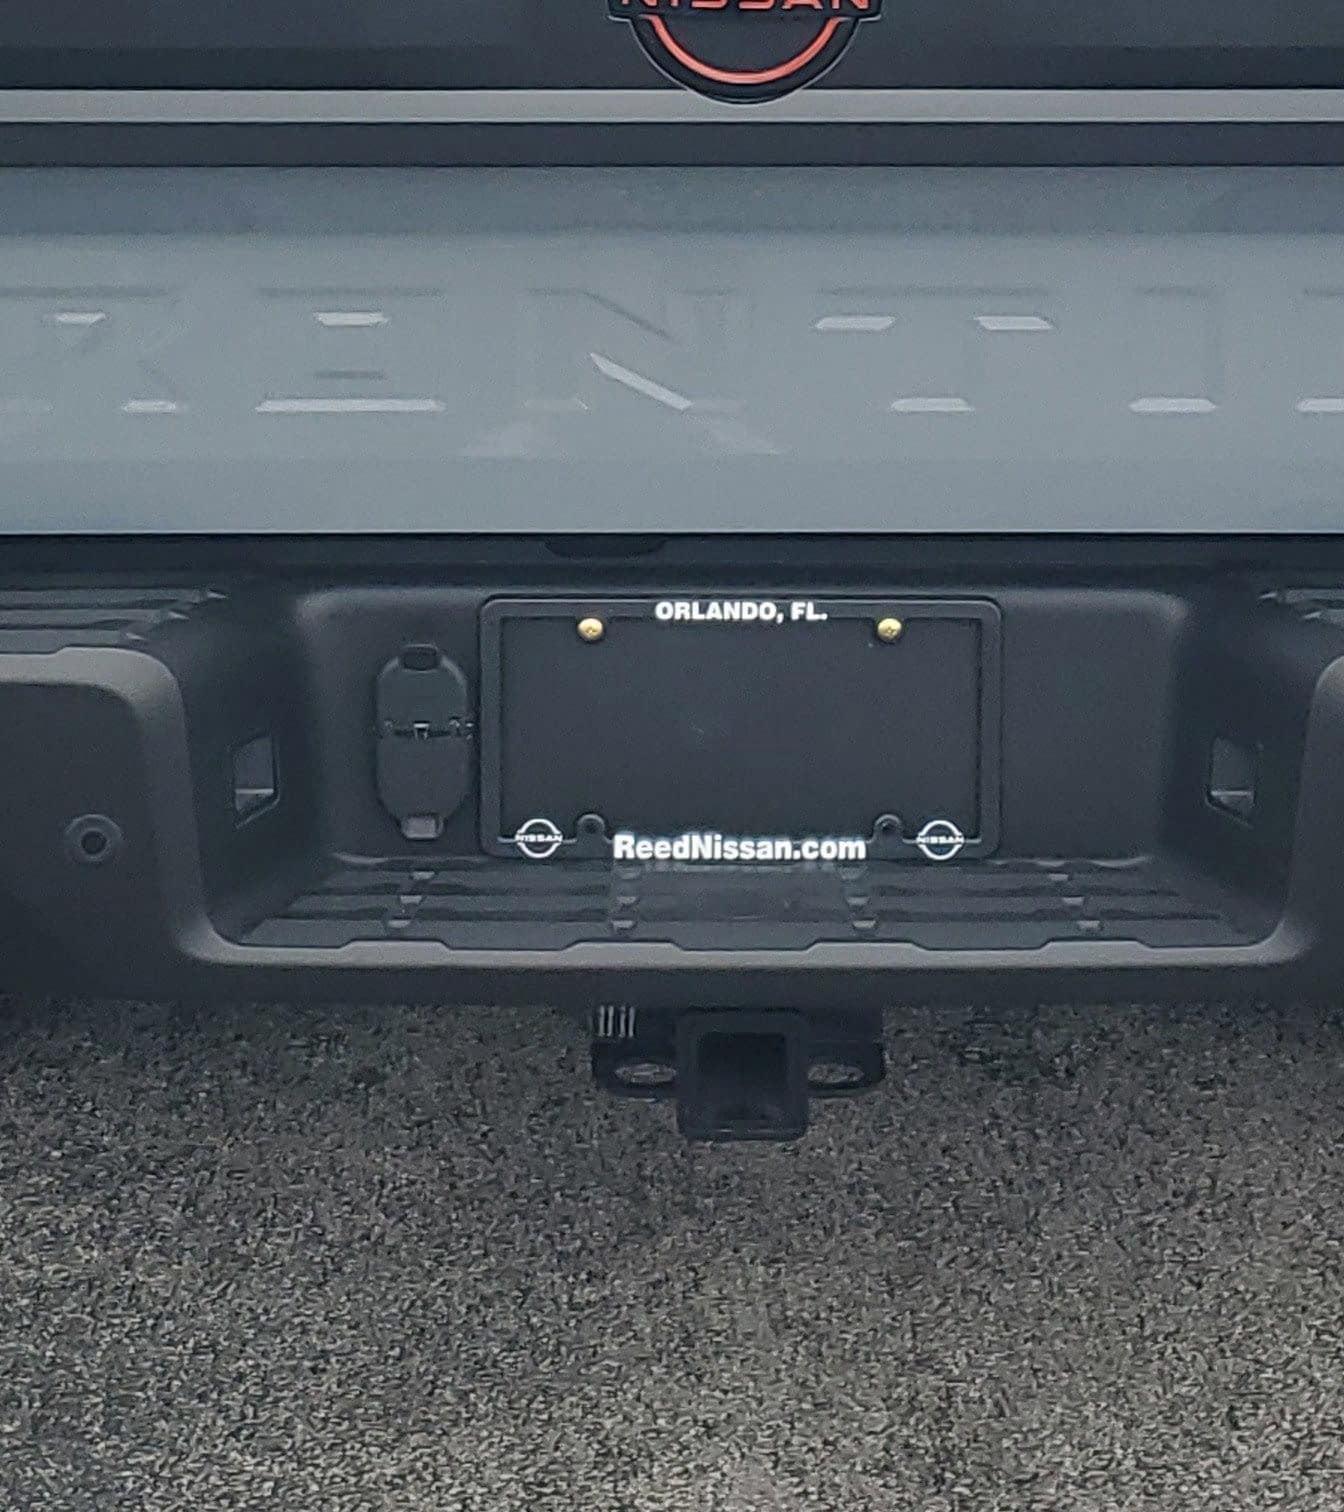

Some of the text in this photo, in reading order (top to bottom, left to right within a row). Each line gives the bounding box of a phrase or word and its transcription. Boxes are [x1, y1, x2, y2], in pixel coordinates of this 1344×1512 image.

[655, 601, 829, 624] ORLANDO, FL.
[612, 834, 868, 860] ReedNissan.com
